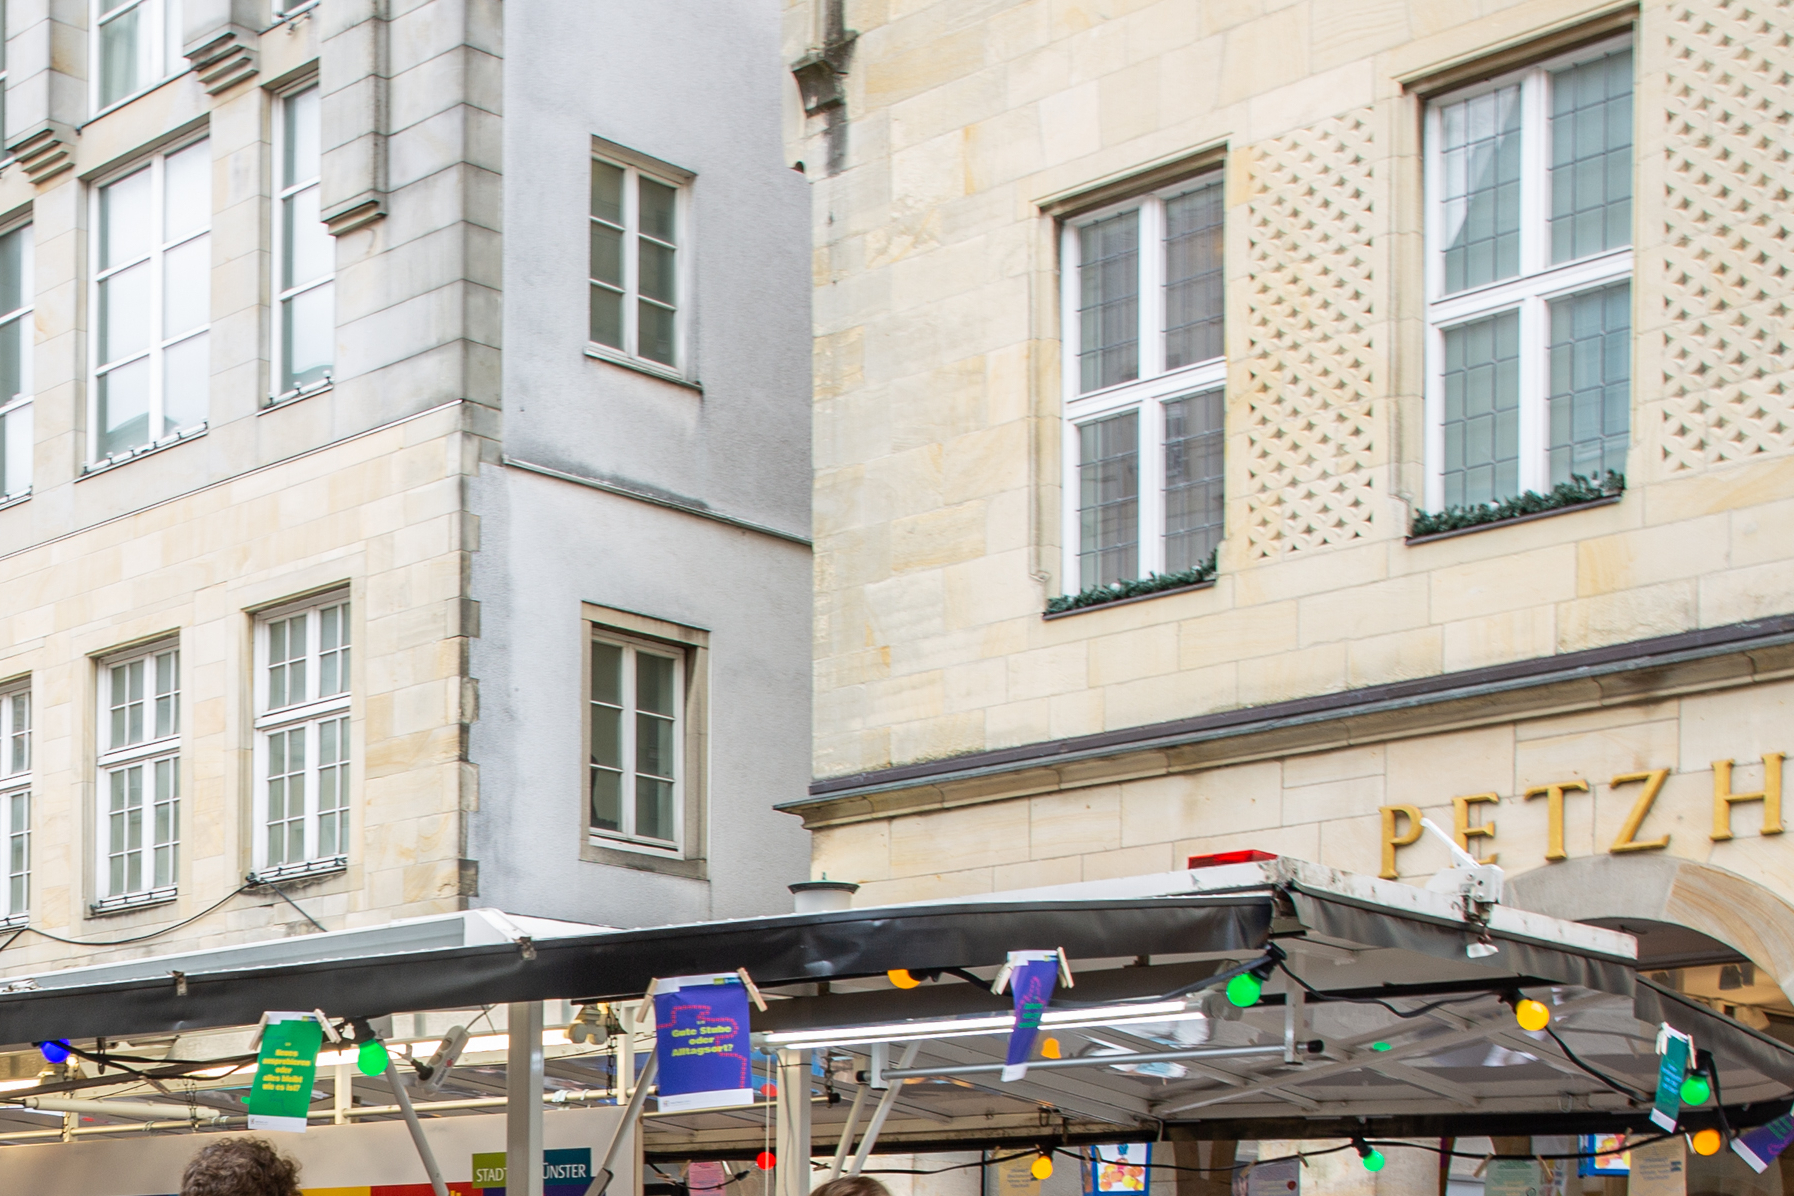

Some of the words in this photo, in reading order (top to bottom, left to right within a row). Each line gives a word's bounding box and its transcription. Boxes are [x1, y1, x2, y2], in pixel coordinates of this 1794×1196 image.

[671, 1028, 697, 1037] Gute
[699, 1025, 732, 1035] Stube
[688, 1036, 715, 1045] oder
[542, 1161, 587, 1179] ÜNSTER
